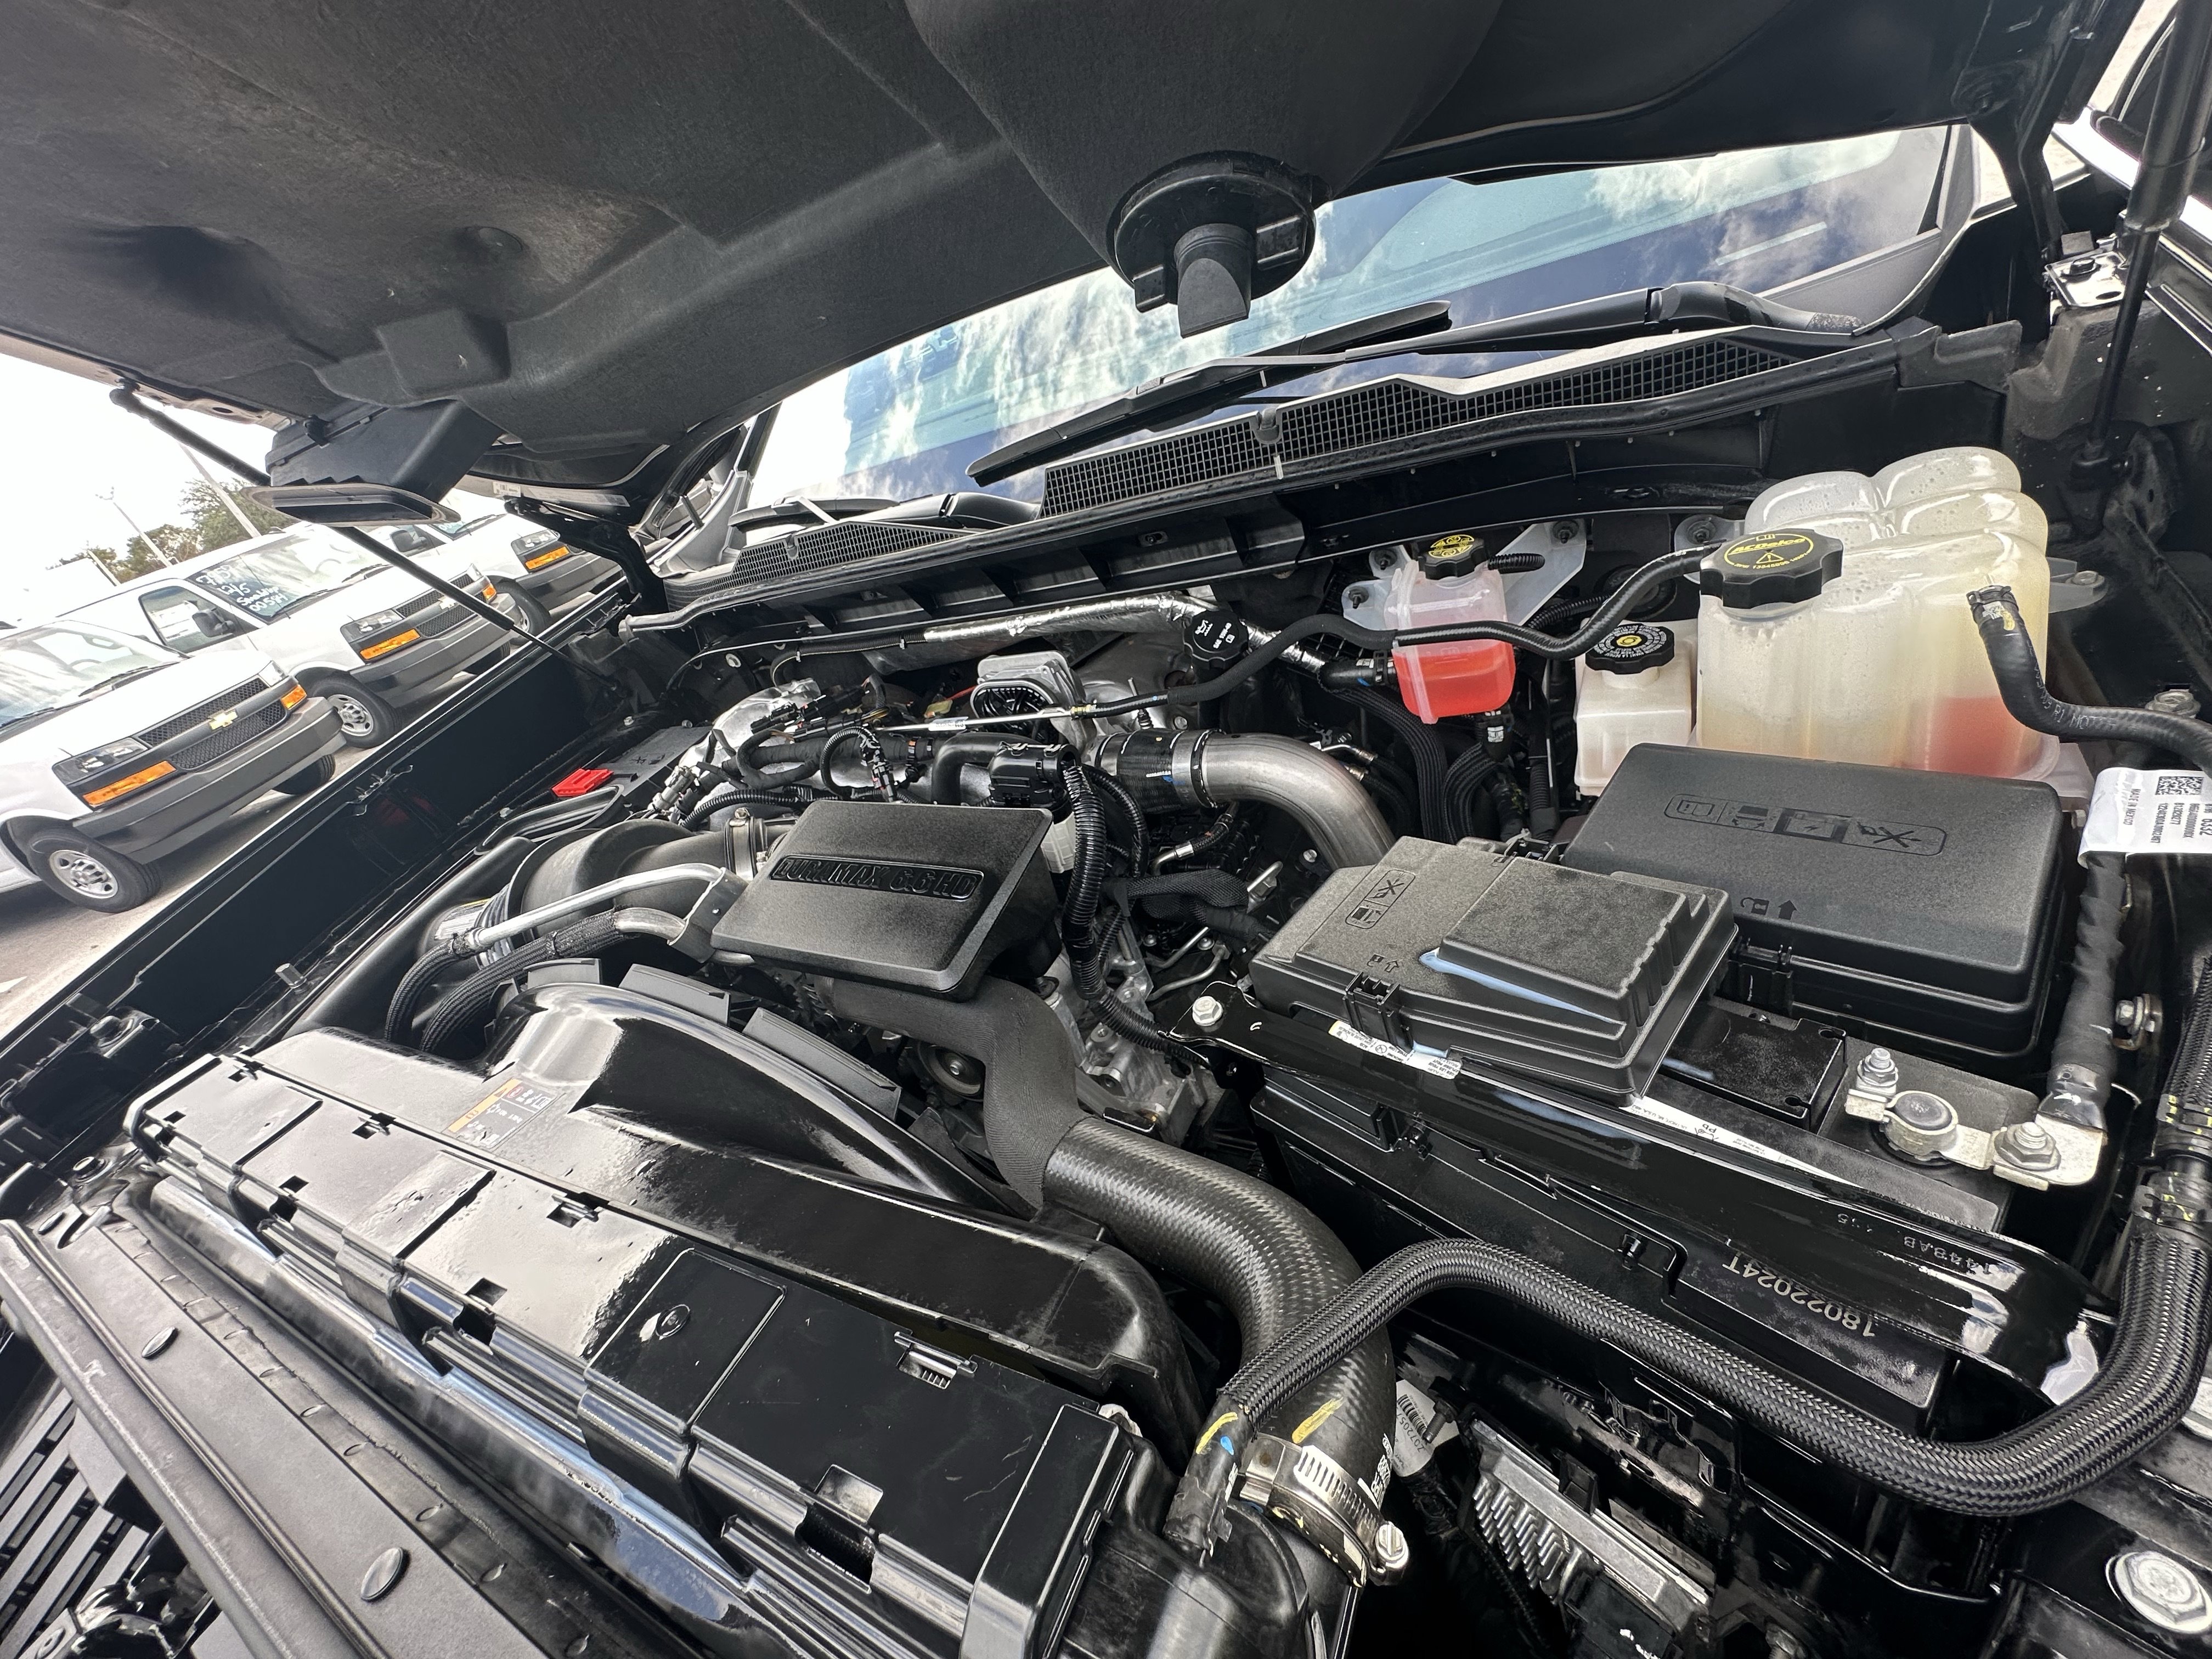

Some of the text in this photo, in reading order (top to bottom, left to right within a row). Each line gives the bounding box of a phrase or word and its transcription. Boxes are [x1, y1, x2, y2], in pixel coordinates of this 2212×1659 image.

[1731, 538, 1806, 553] ACDelco
[2129, 788, 2141, 801] MADE
[2123, 808, 2136, 825] MEXICO
[772, 859, 980, 899] DURAMAX 6.6 HD
[1702, 1123, 1717, 1134] Pb
[1723, 1251, 1876, 1337] 18022024T
